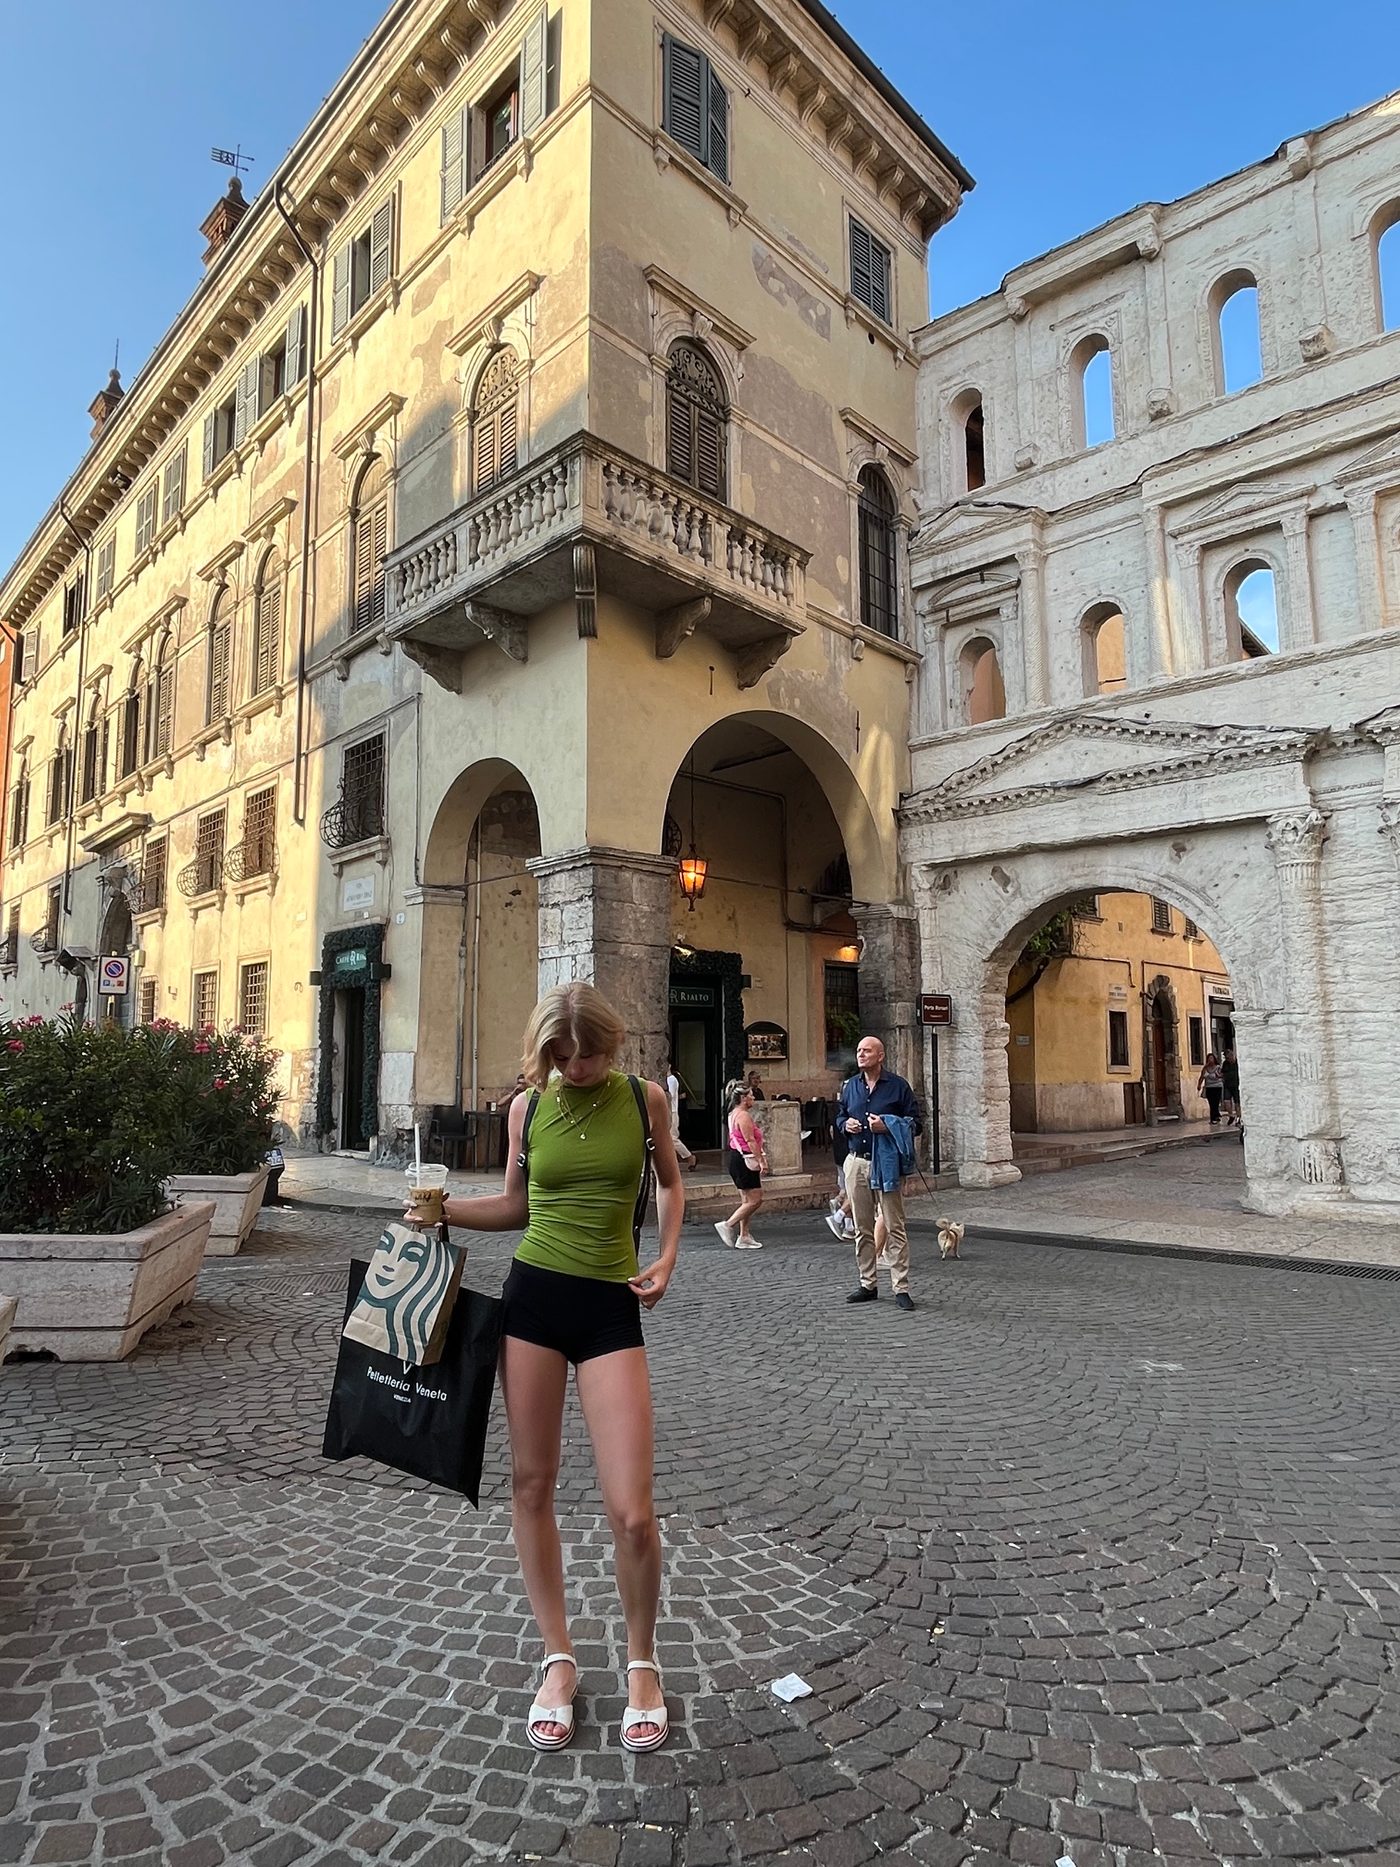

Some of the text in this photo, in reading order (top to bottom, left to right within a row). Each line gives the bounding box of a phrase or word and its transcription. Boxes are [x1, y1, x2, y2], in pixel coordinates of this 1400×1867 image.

[680, 991, 709, 1001] RIALTO
[366, 1366, 448, 1402] Pelletteria Veneta
